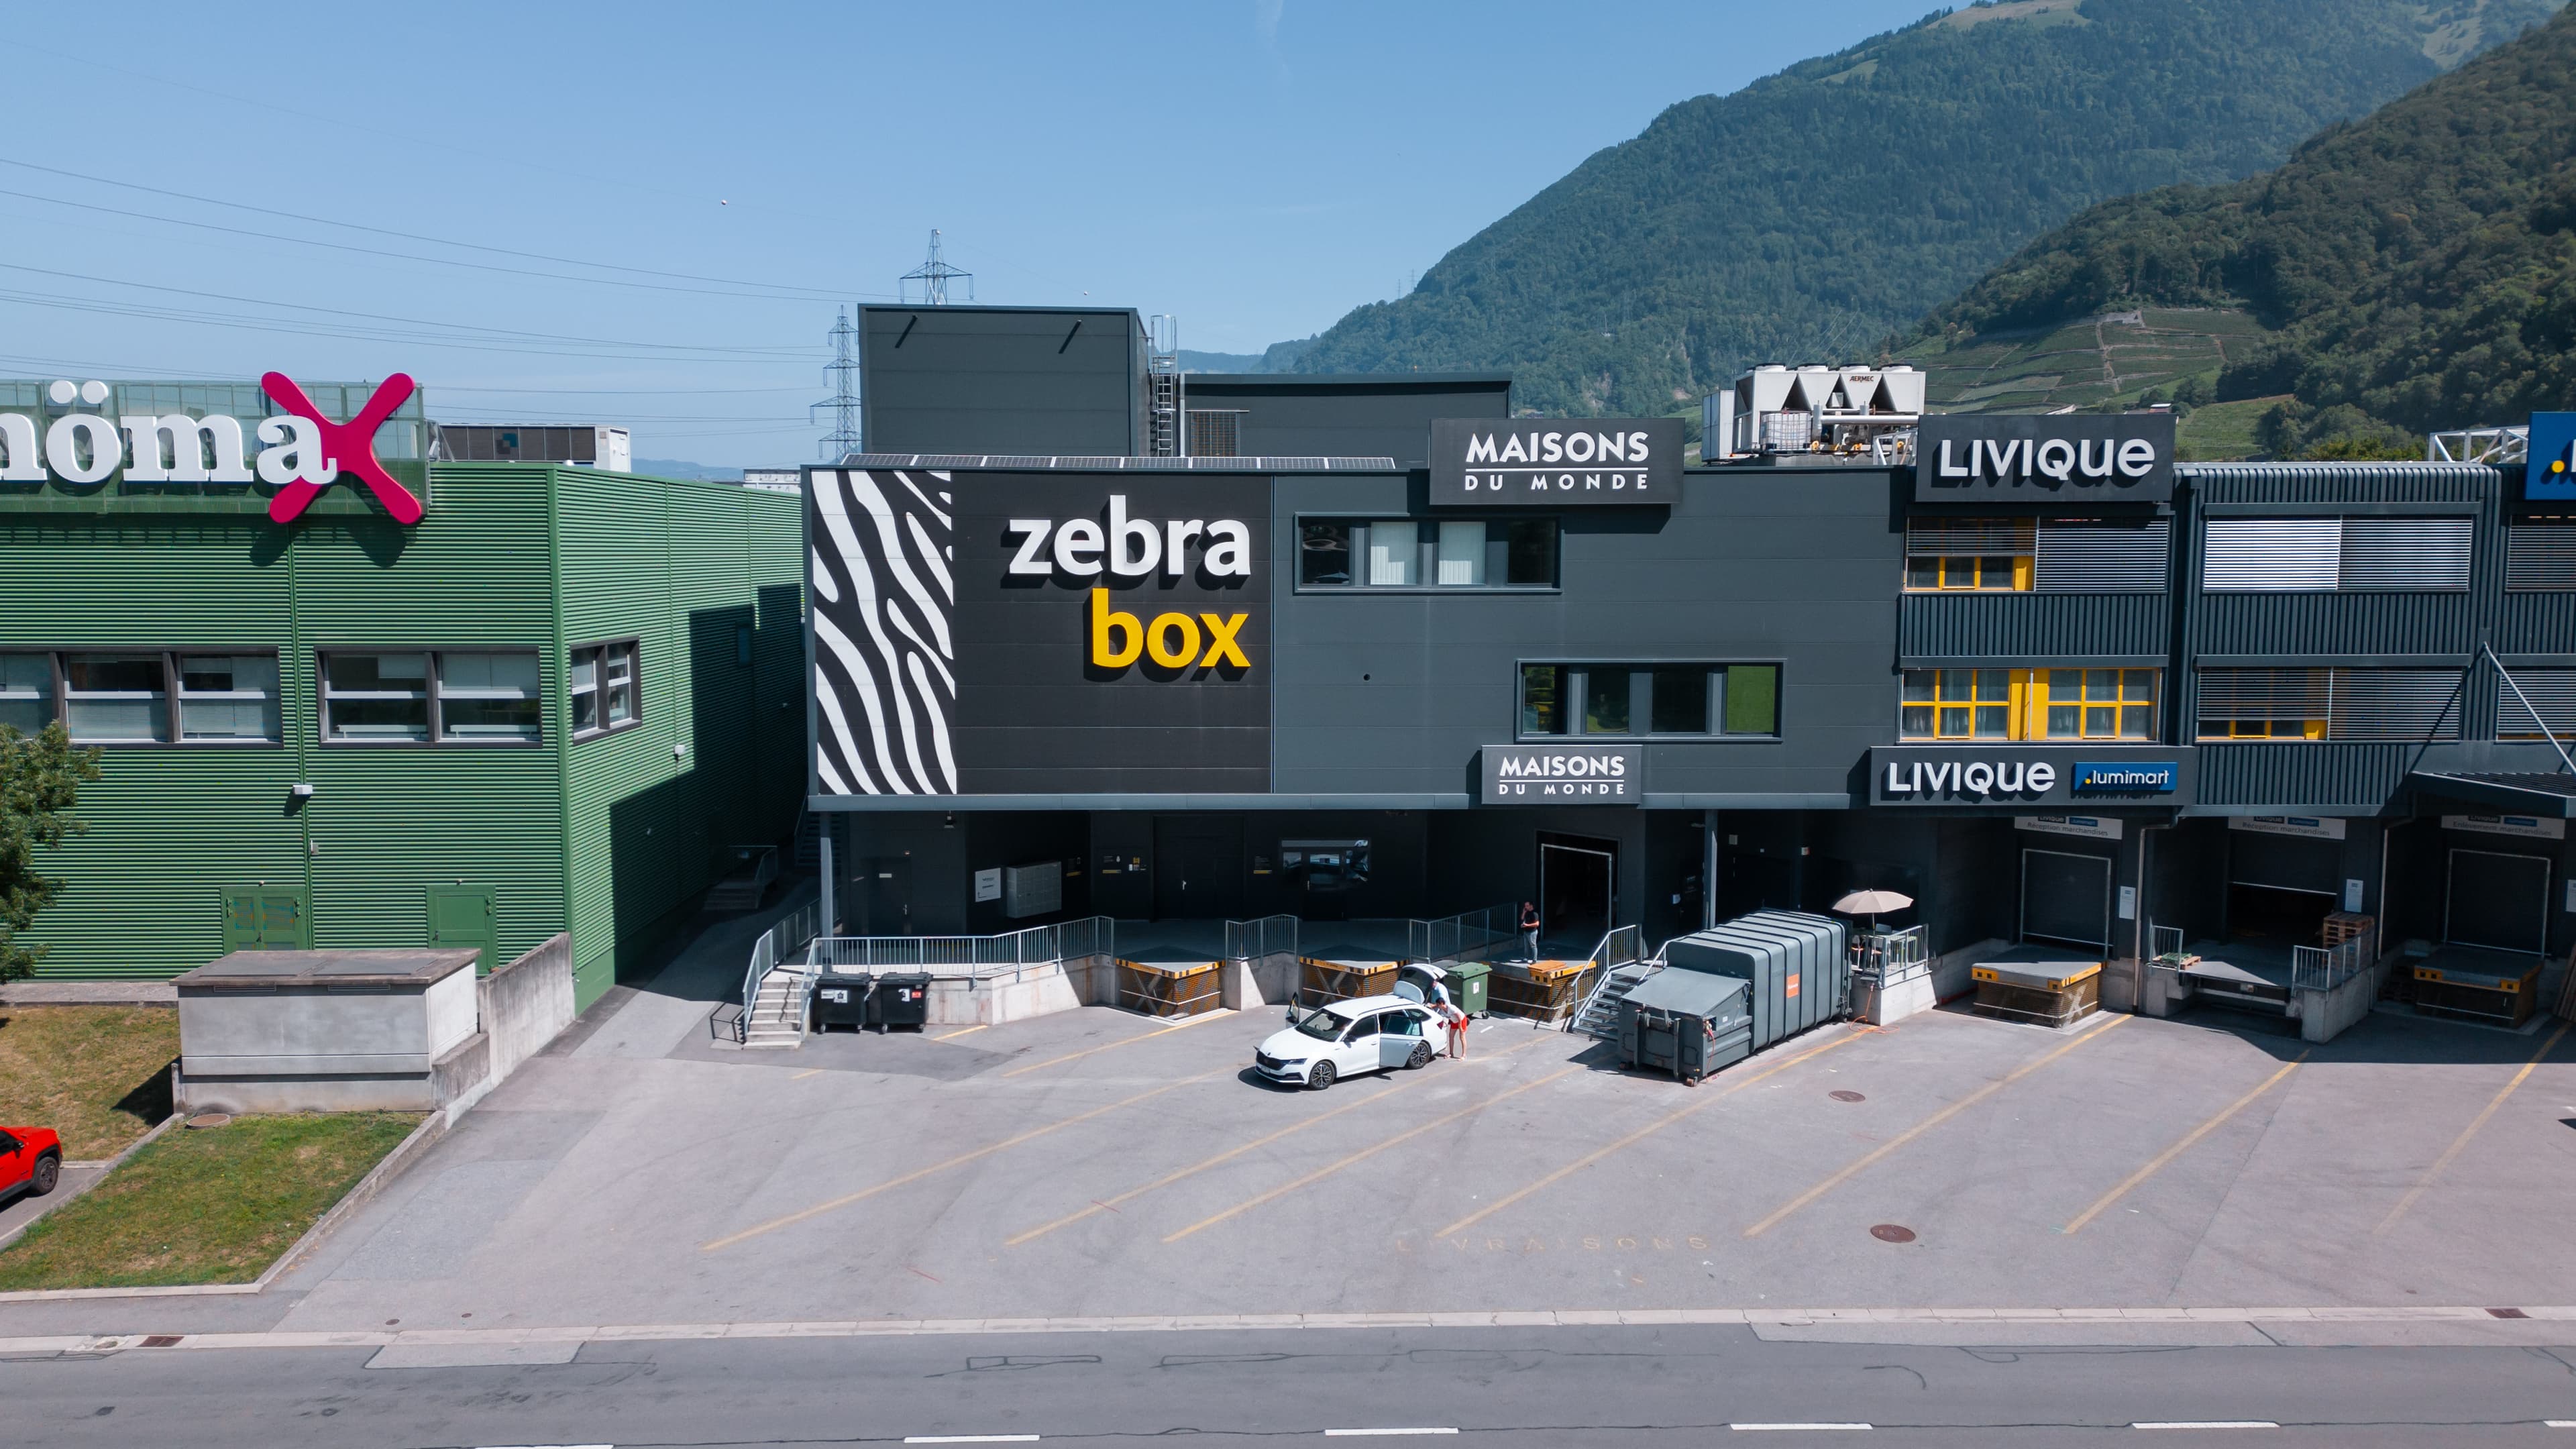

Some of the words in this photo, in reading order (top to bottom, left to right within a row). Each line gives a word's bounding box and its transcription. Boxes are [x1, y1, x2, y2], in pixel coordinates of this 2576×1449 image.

[1466, 431, 1649, 463] MAISONS
[1464, 474, 1503, 490] DU
[1530, 473, 1648, 490] MONDE
[1009, 494, 1251, 576] zebra
[1092, 587, 1251, 668] box
[1499, 755, 1625, 777] MAISONS
[1499, 784, 1526, 795] DU
[1544, 783, 1625, 795] MONDE
[2061, 826, 2109, 837] marchandises
